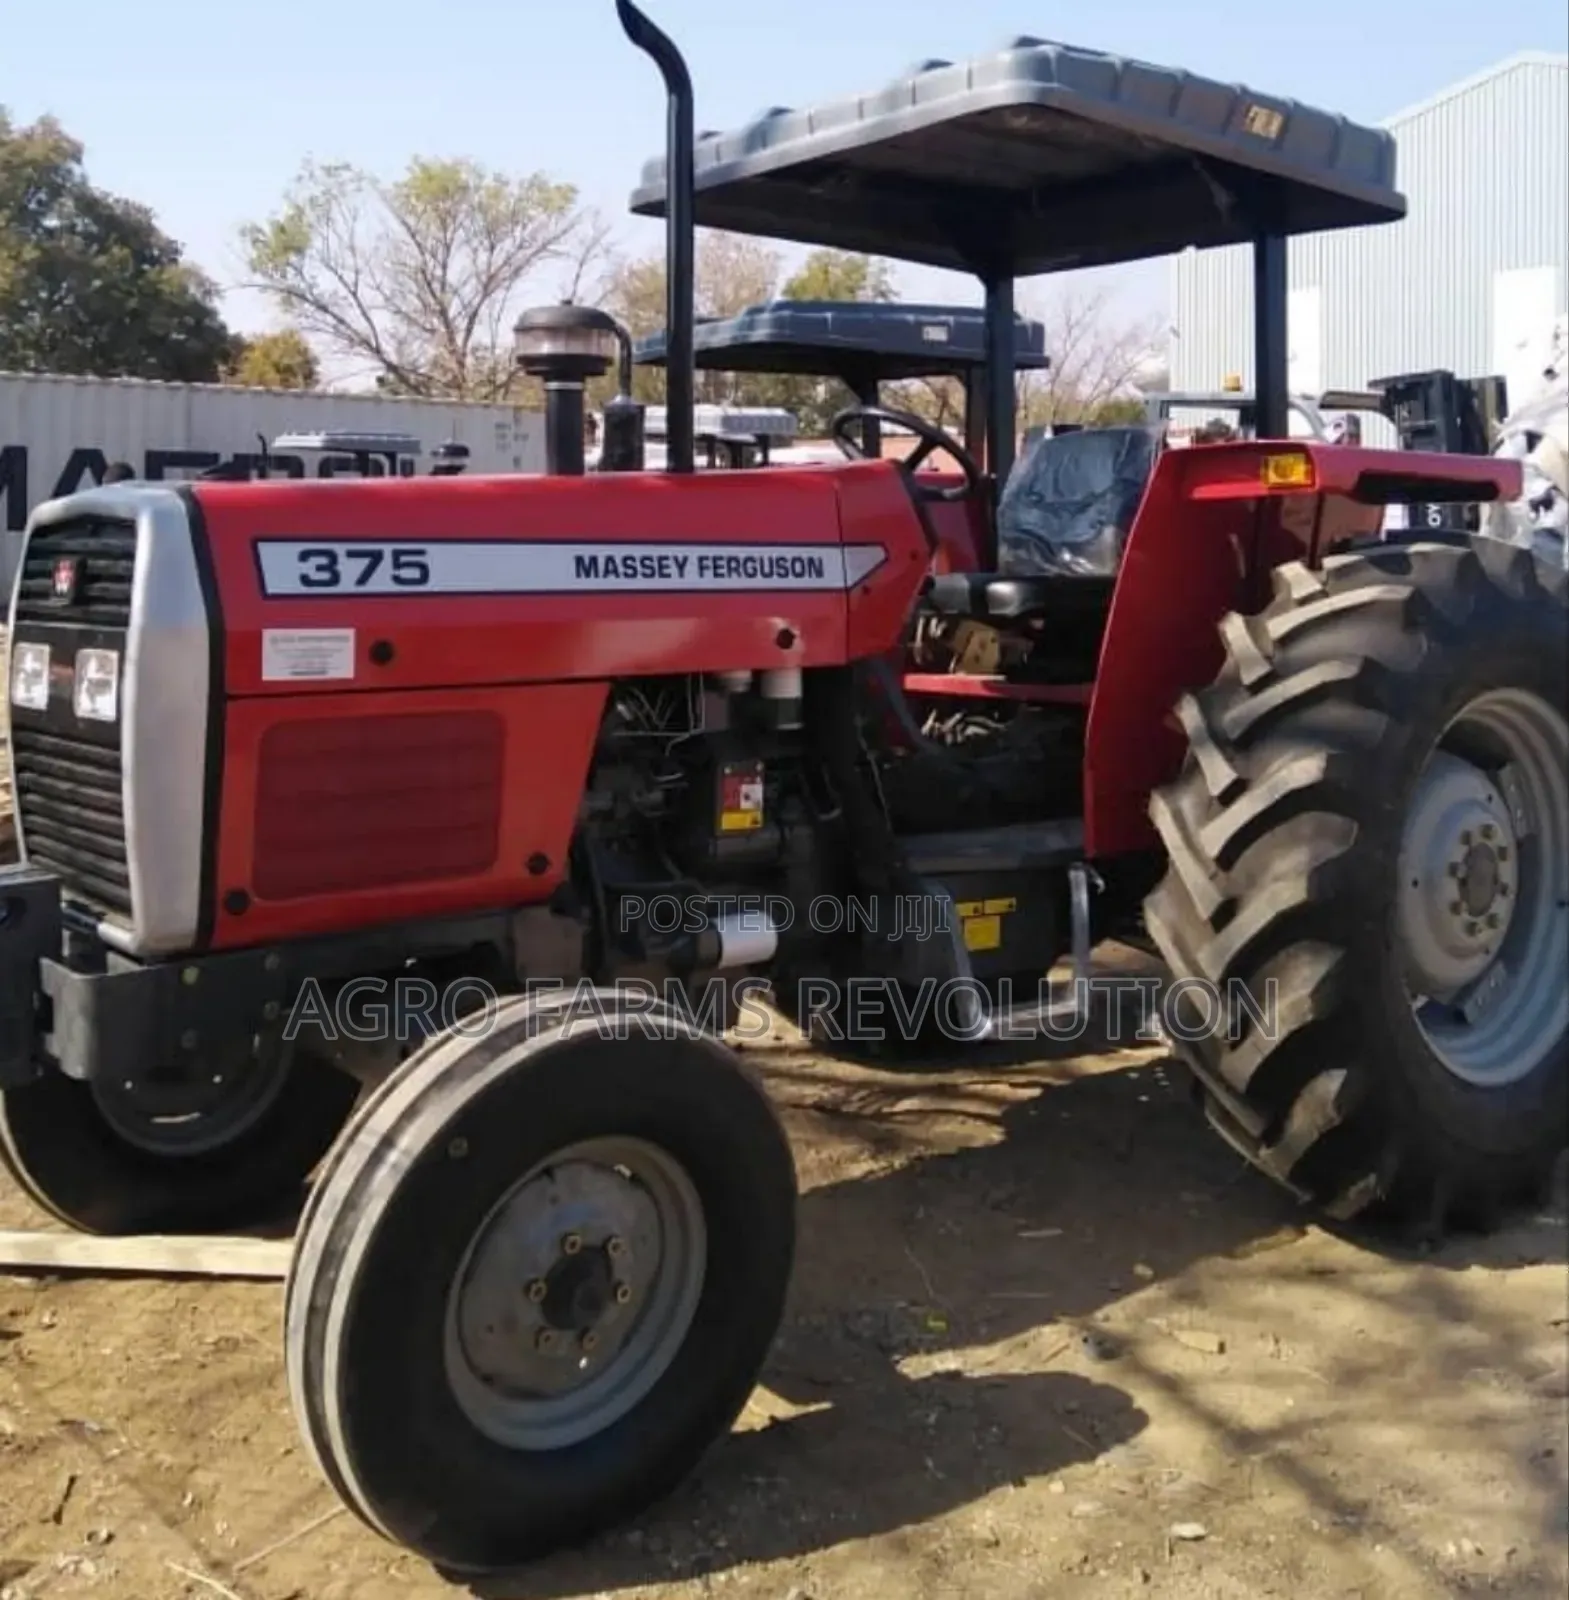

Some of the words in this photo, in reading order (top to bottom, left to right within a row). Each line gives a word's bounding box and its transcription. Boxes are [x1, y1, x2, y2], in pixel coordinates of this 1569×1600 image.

[298, 549, 430, 588] 375
[574, 555, 689, 579] MASSEY
[697, 556, 825, 579] FERGUSON
